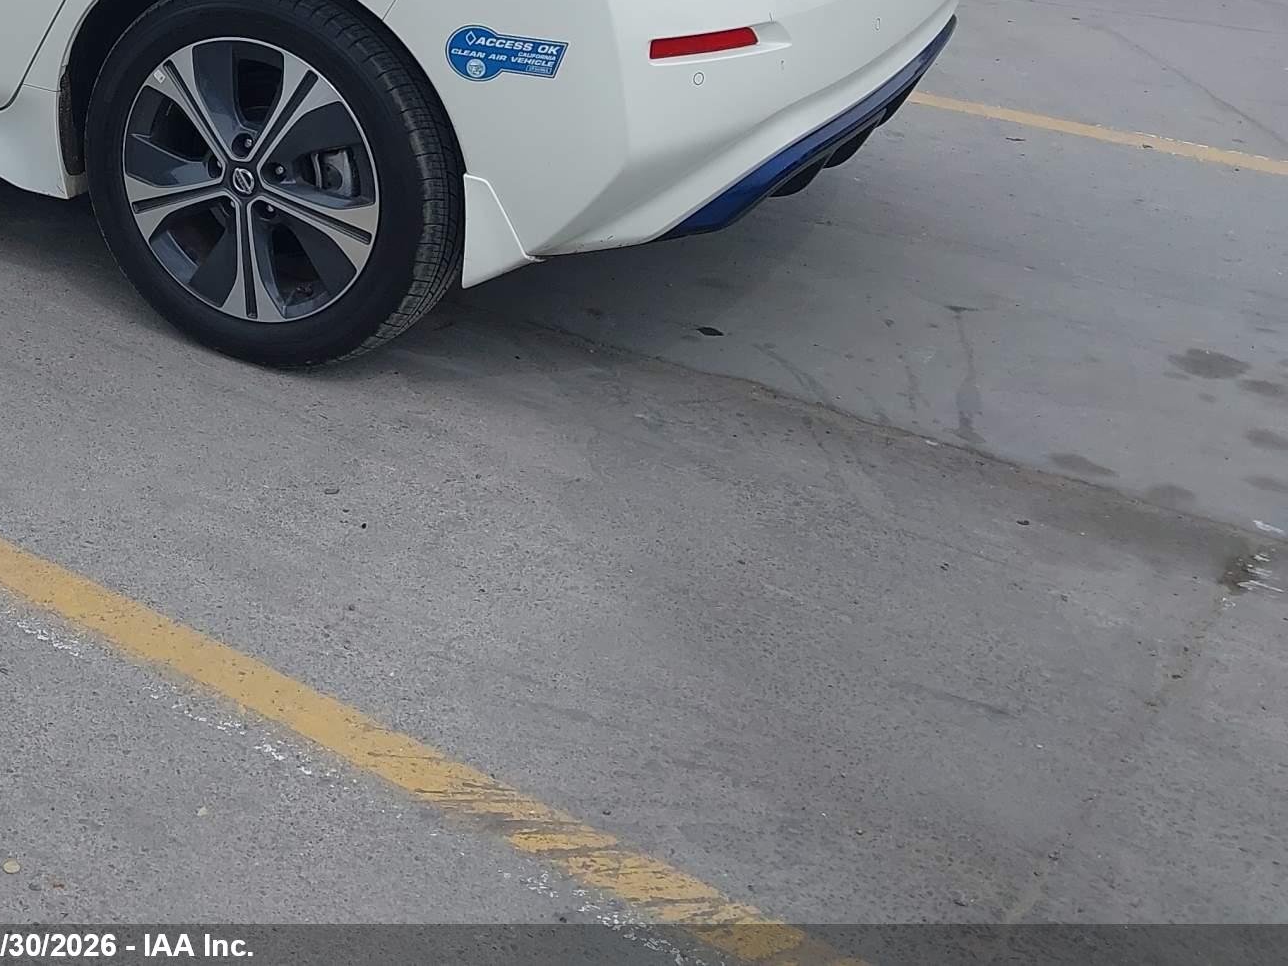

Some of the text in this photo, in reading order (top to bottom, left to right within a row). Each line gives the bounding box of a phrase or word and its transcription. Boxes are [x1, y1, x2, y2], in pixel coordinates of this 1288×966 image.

[476, 37, 561, 55] ACCESS OK
[451, 48, 555, 67] CLEAN AIR VEHICLE
[518, 52, 556, 61] CALIFORNIA
